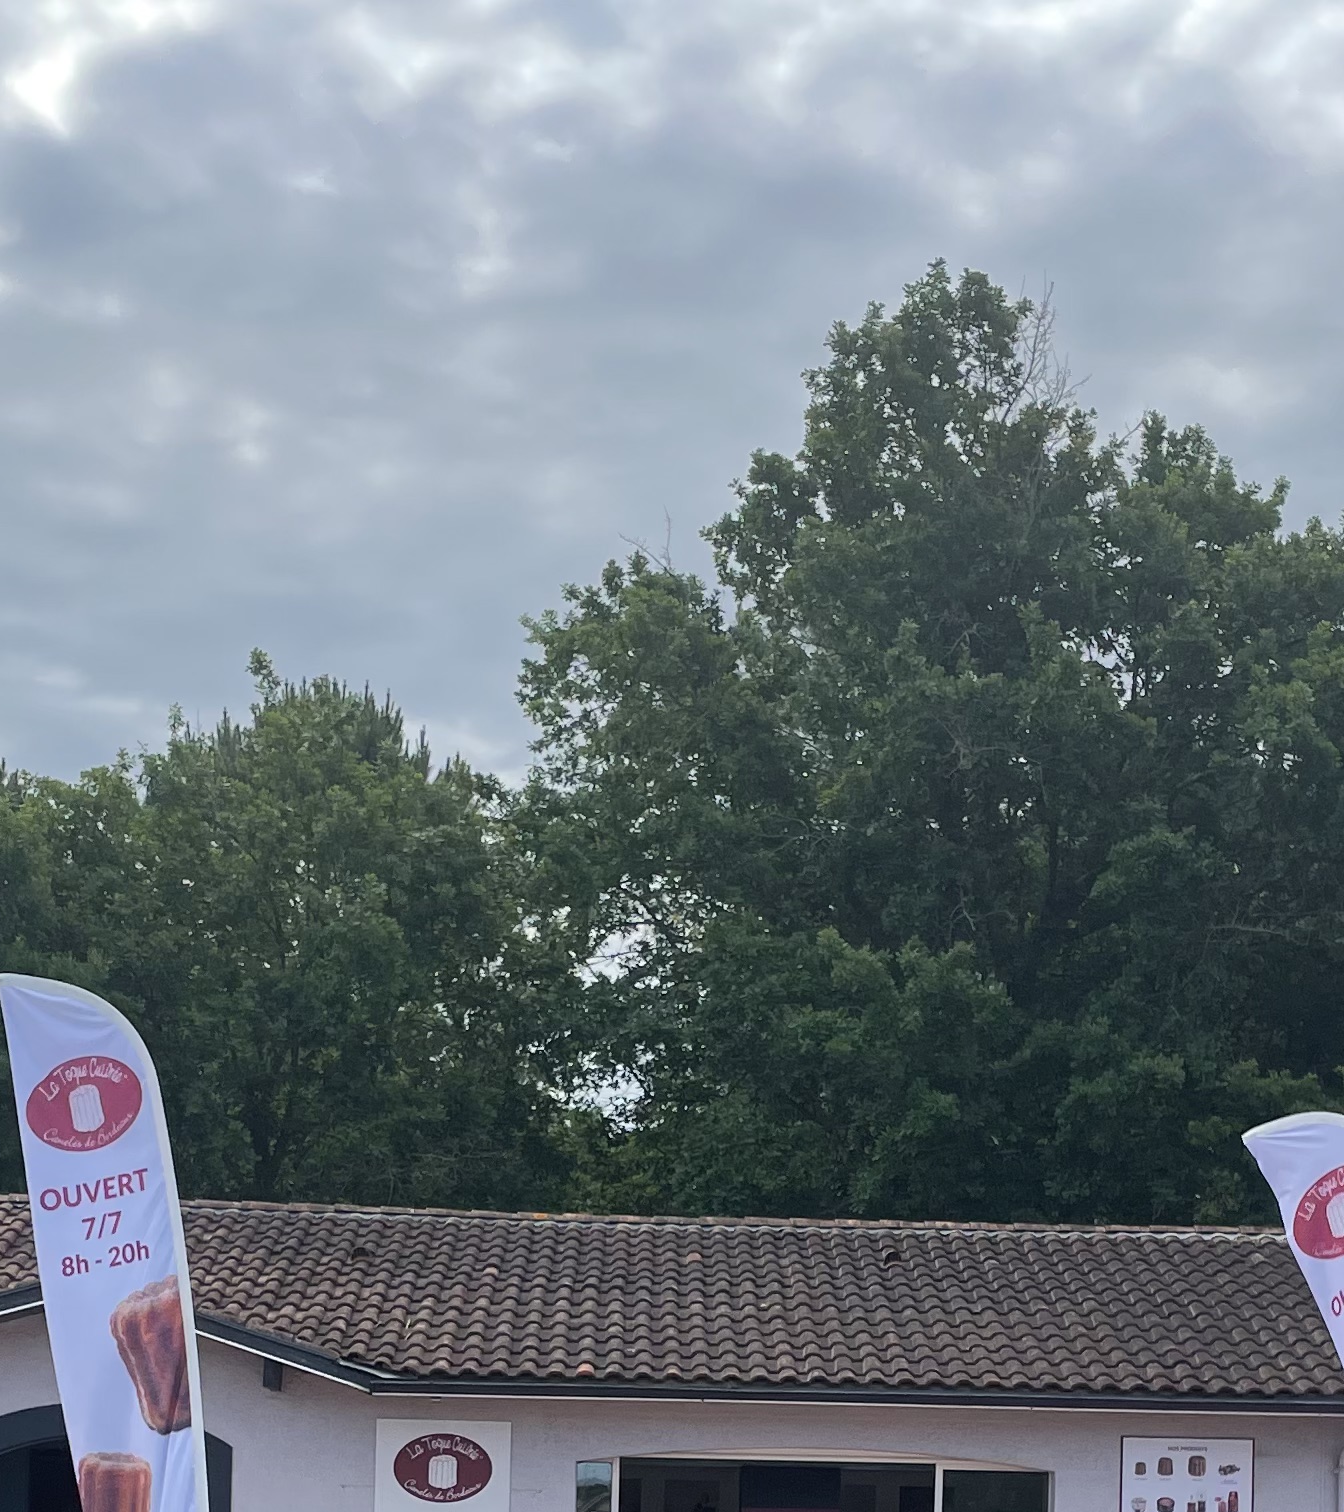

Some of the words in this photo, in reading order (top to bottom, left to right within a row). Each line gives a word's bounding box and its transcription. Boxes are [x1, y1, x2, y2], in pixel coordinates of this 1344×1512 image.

[40, 1168, 148, 1211] OUVERT
[82, 1211, 122, 1240] 7/7
[62, 1254, 89, 1277] 8h
[108, 1240, 150, 1268] 20h
